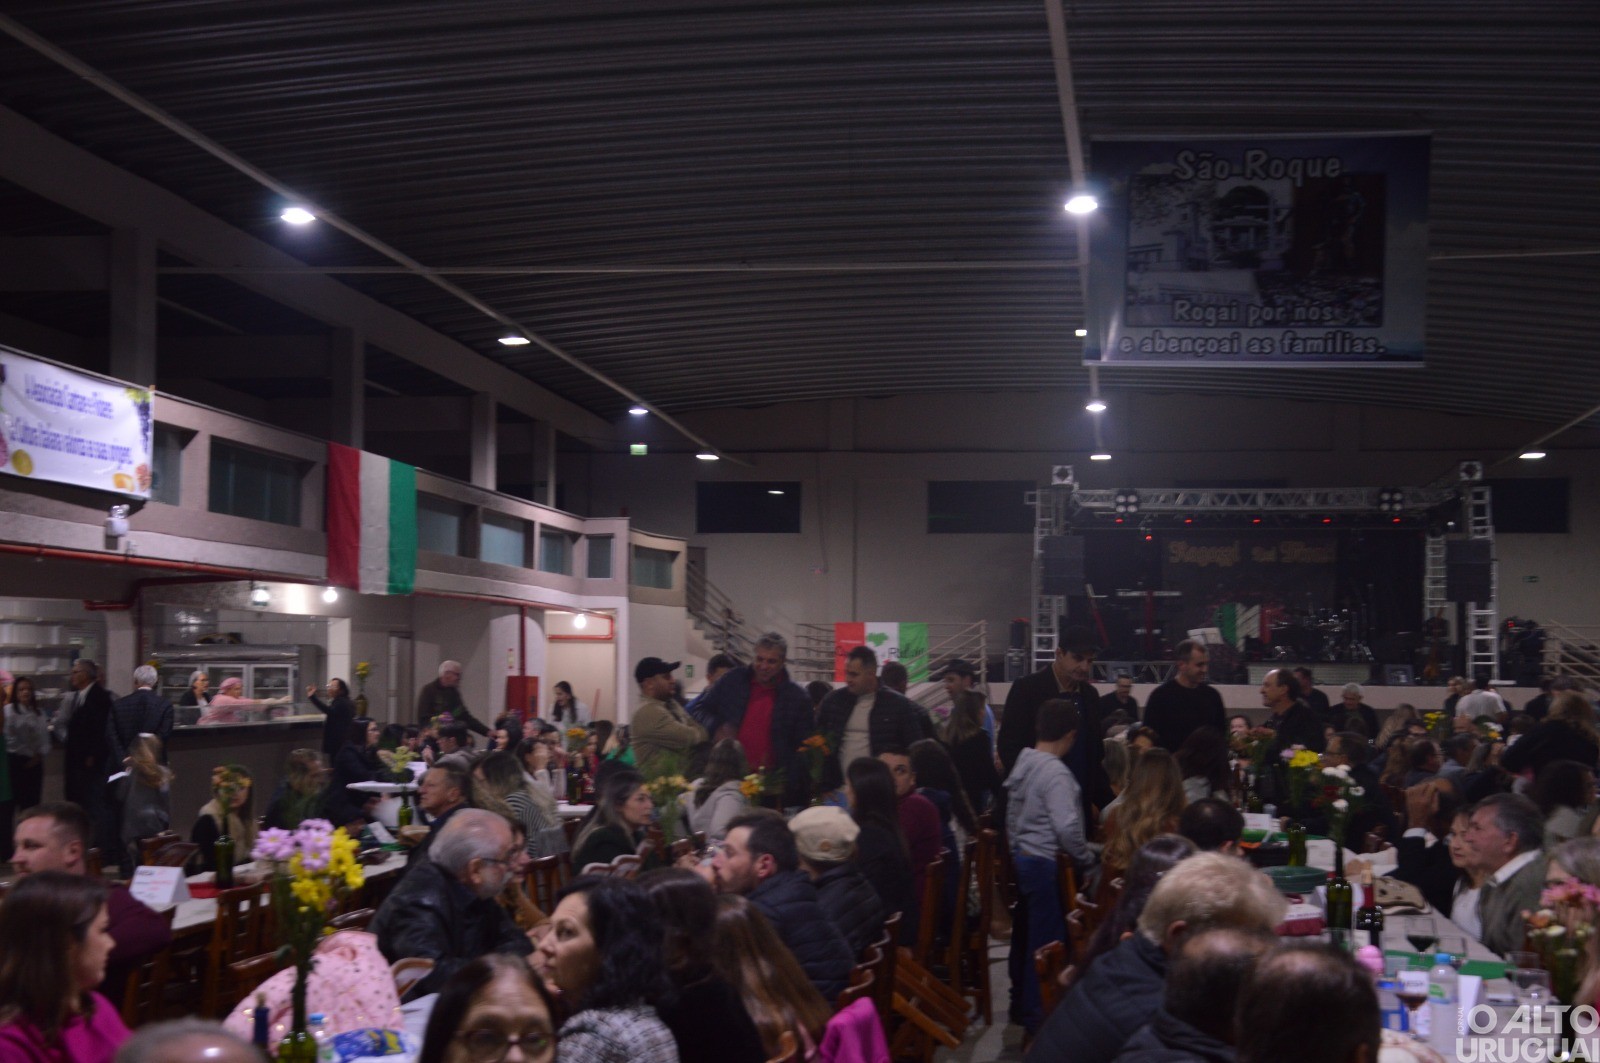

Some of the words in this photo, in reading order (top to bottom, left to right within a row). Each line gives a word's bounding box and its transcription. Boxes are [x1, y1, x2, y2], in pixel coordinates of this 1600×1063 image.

[1173, 149, 1231, 180] São
[1244, 148, 1342, 188] Roque
[1173, 298, 1239, 327] Rogai
[1247, 304, 1286, 327] por
[1119, 336, 1135, 354] e
[1140, 330, 1241, 357] abençoai
[1247, 336, 1274, 354] as
